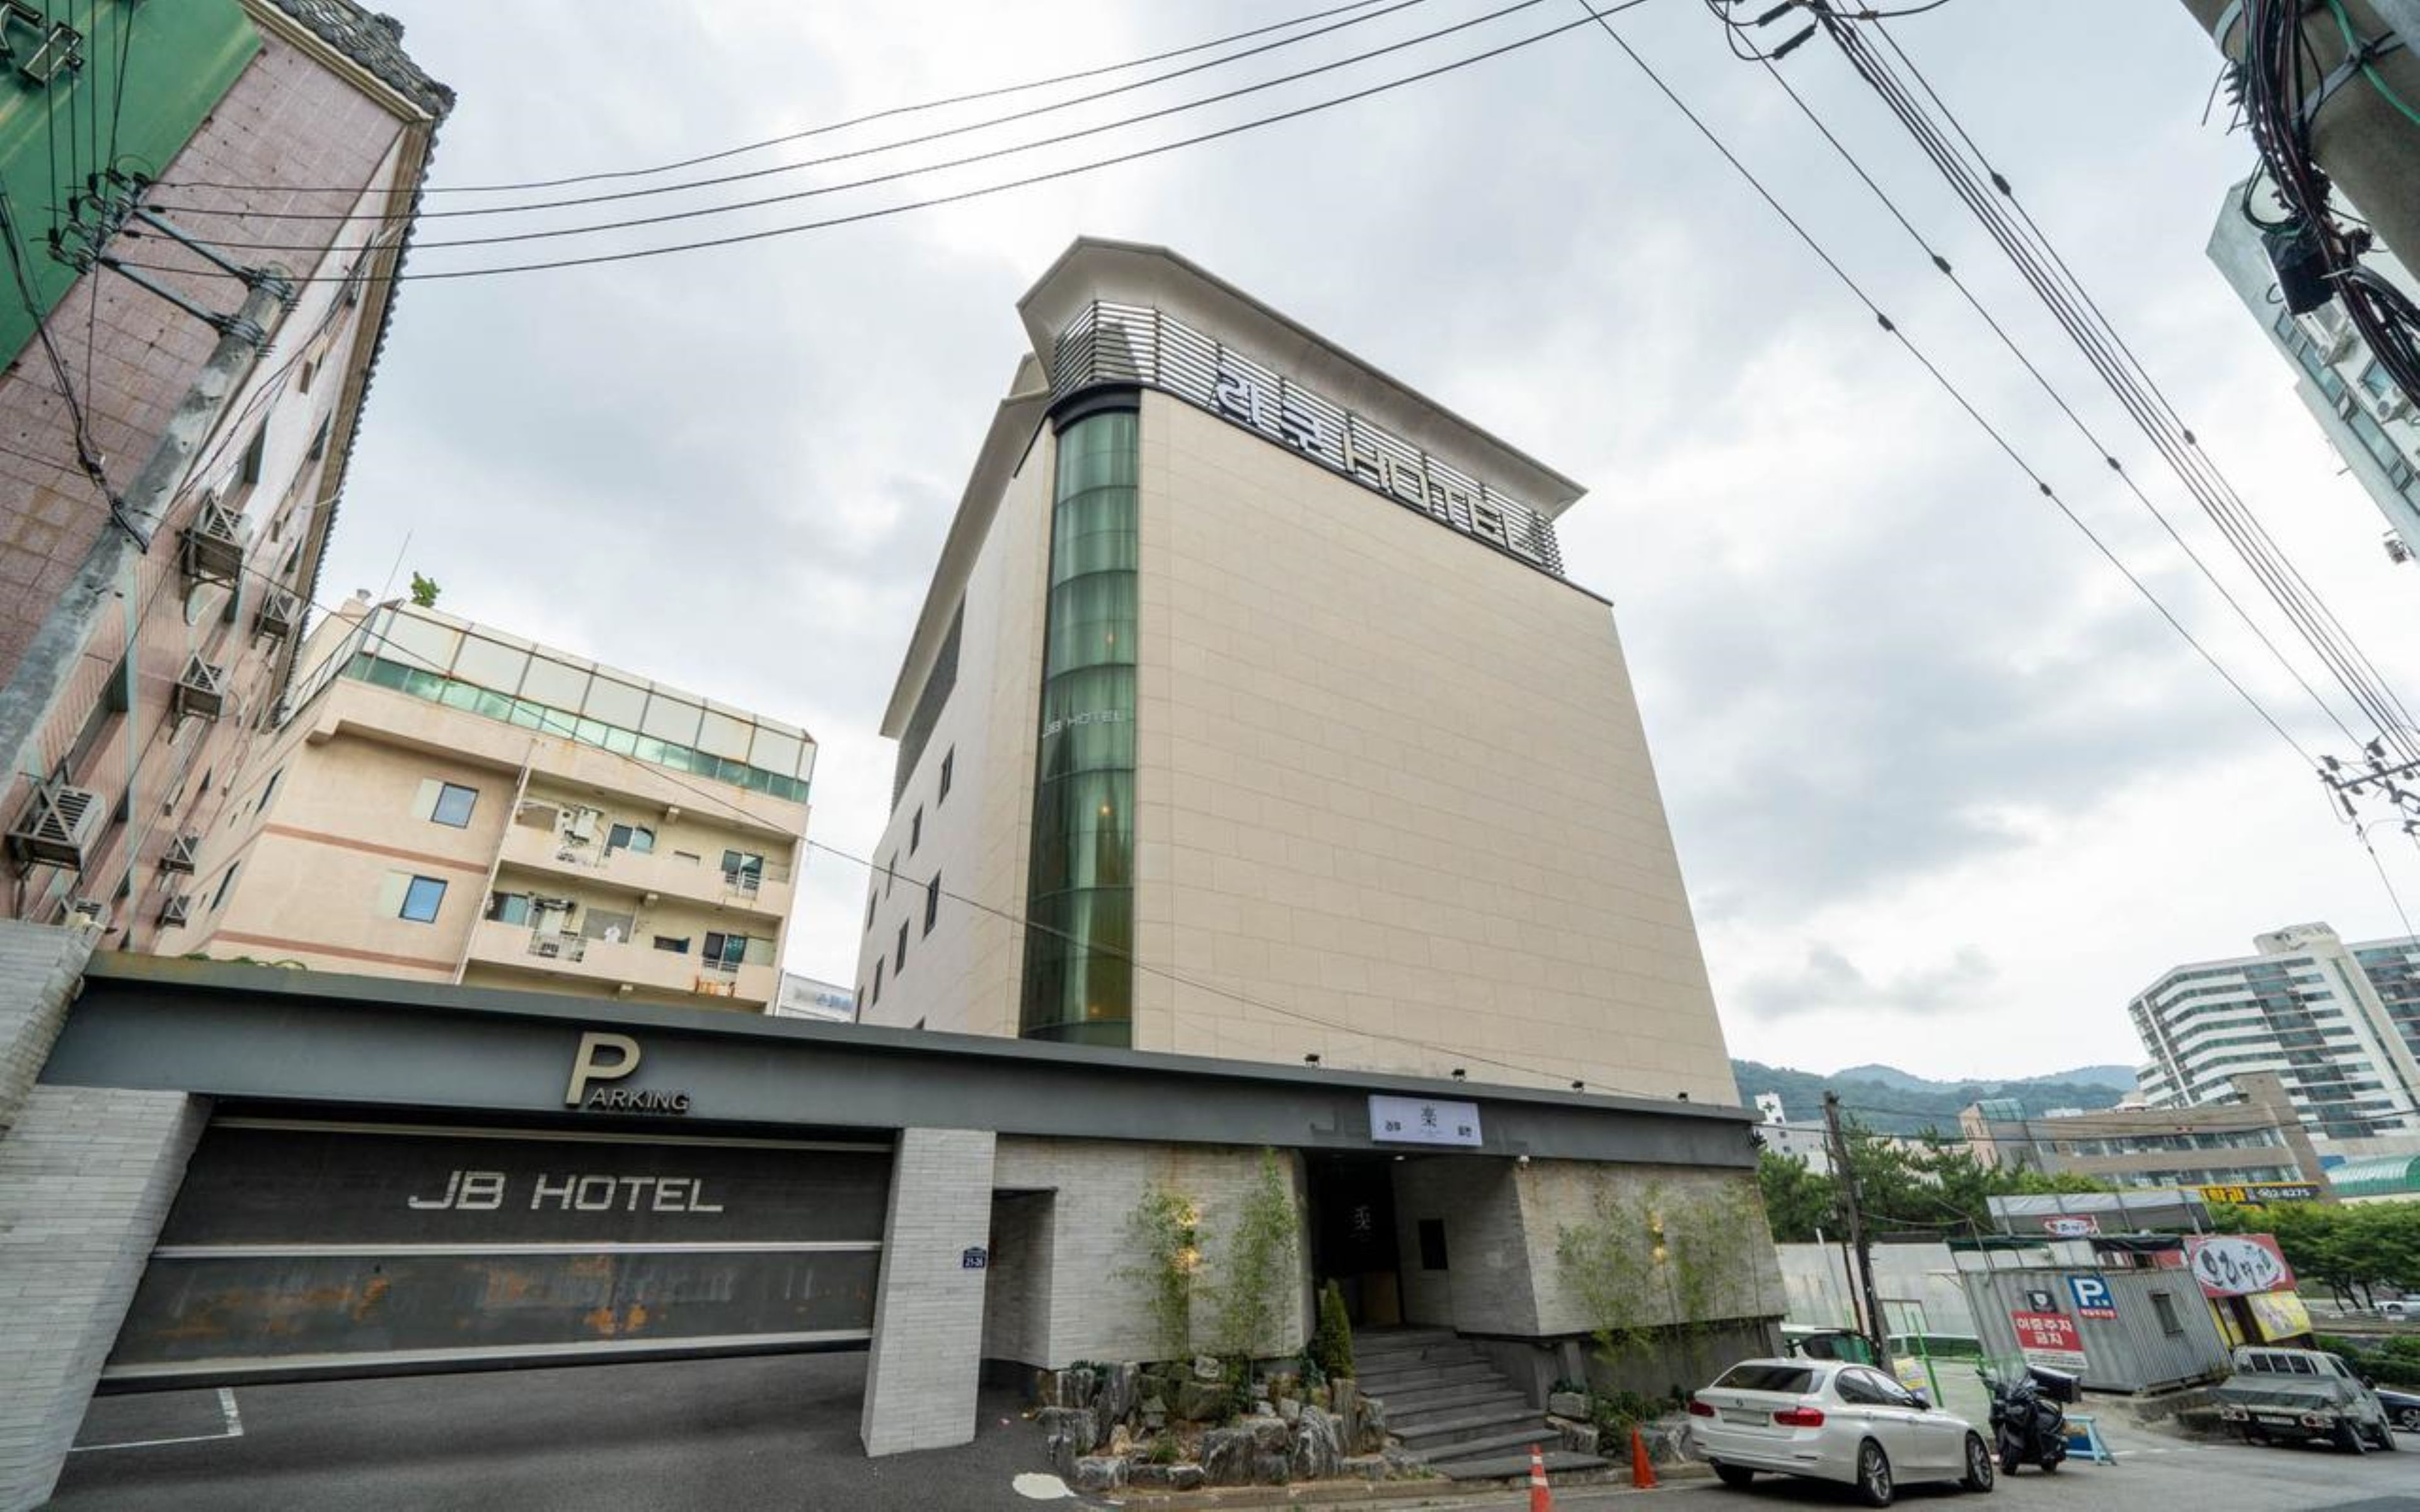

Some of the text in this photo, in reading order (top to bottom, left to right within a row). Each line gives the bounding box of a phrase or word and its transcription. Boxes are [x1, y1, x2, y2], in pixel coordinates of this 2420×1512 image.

[1342, 430, 1542, 564] HOTEL
[566, 1032, 691, 1110] PARKING
[408, 1171, 724, 1211] JB HOTEL
[2073, 1278, 2104, 1306] P
